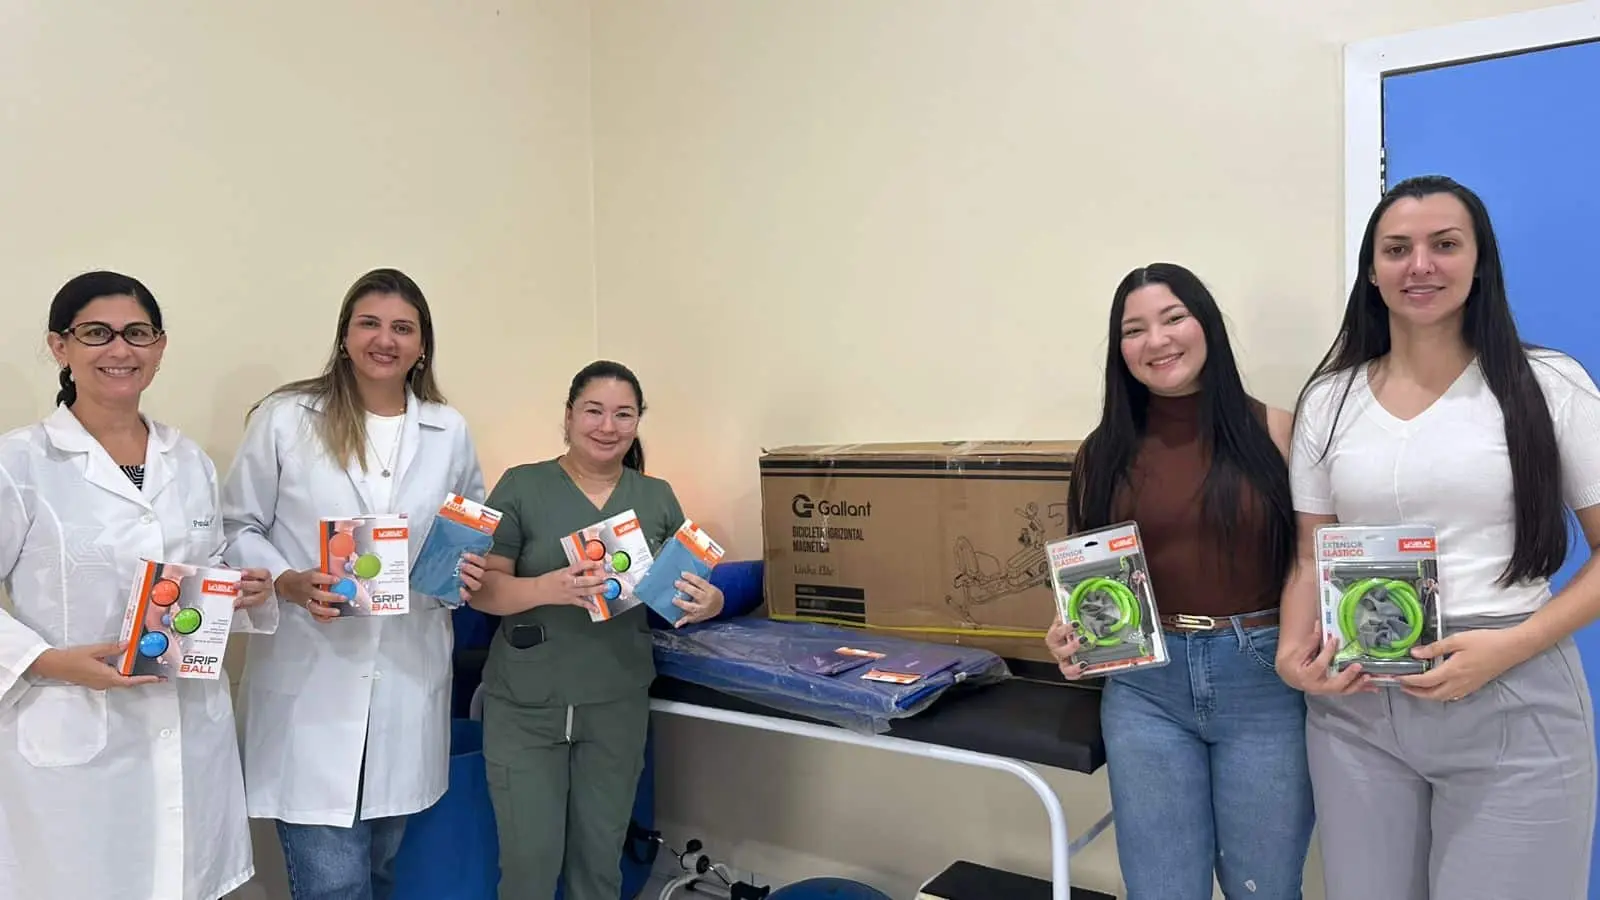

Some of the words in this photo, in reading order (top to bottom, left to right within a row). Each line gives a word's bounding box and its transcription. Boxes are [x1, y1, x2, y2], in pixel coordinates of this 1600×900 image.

[818, 500, 872, 516] Gallant
[792, 526, 825, 539] BICICLETA
[827, 527, 865, 541] HORIZONTAL
[372, 594, 404, 603] GRIP
[372, 603, 405, 611] BALL
[183, 655, 218, 665] GRIP
[180, 664, 215, 674] BALL
